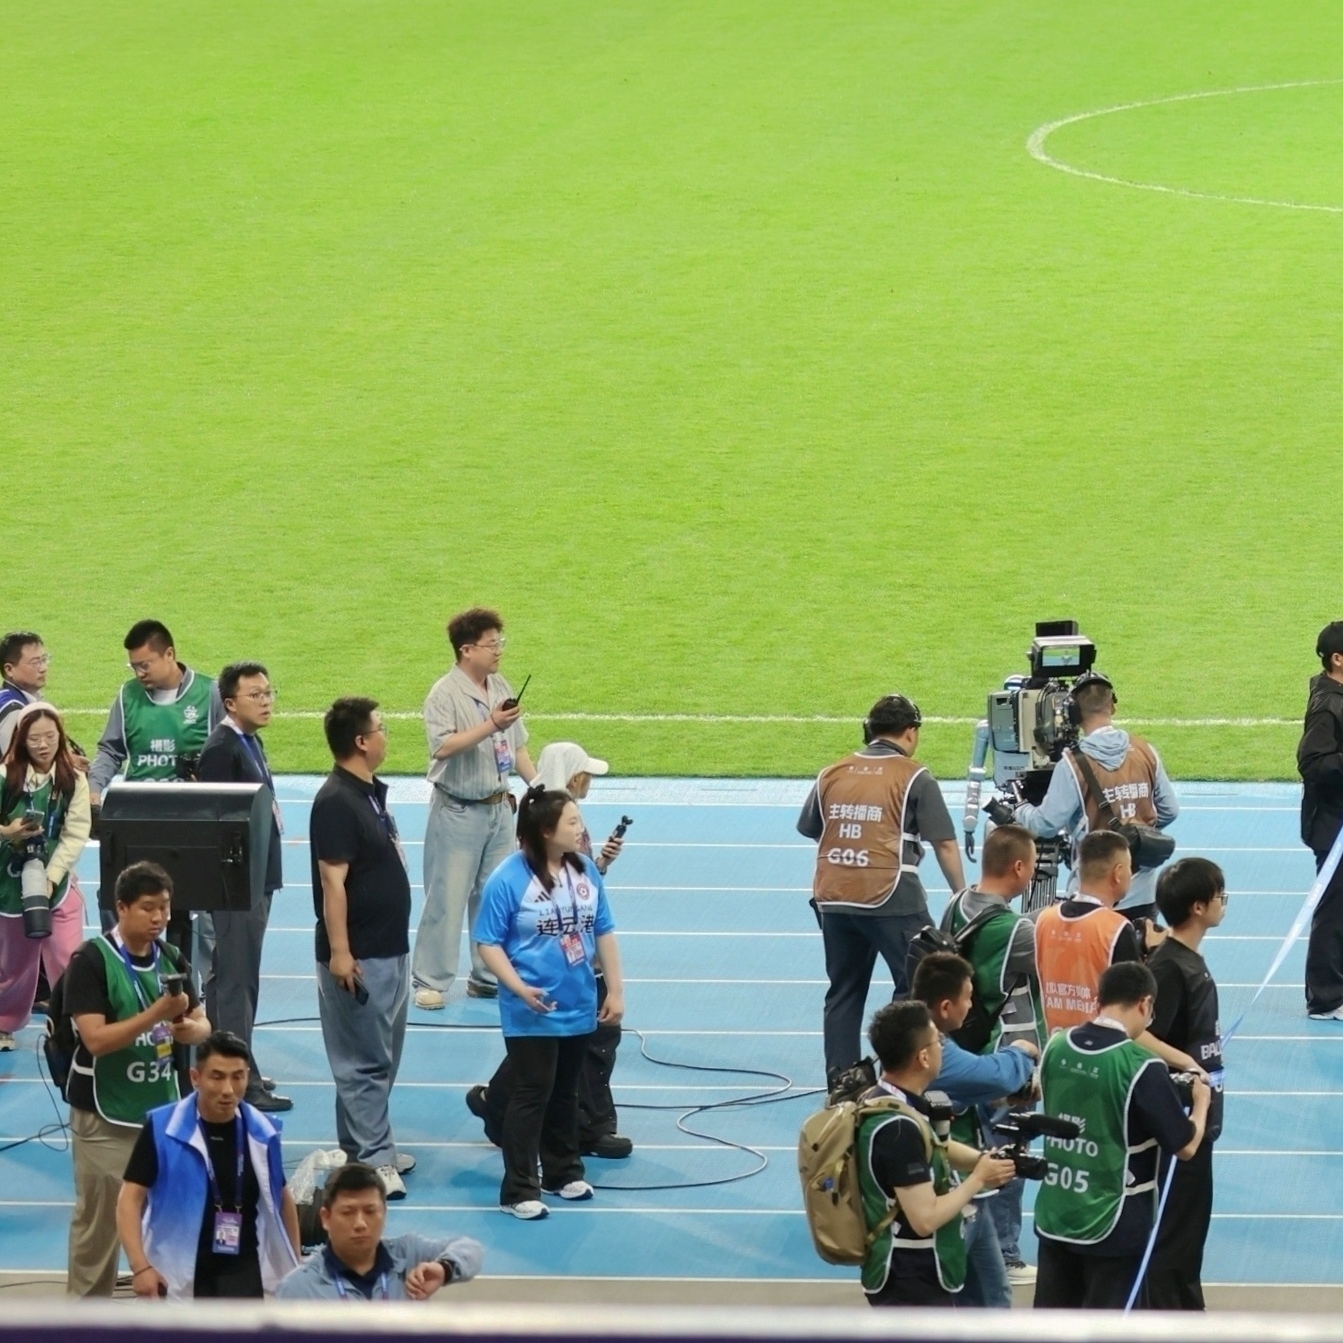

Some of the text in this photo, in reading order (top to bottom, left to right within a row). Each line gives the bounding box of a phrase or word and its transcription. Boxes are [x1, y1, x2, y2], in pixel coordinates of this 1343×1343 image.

[136, 753, 178, 767] PHOT
[828, 803, 883, 823] 主转播商
[1119, 803, 1137, 819] HB
[838, 823, 862, 839] HB
[827, 847, 870, 868] G06
[536, 914, 595, 937] 连云港
[1045, 982, 1092, 1000] 队官方媒体
[126, 1060, 173, 1083] G34
[1046, 1135, 1099, 1158] HOTO
[1044, 1161, 1091, 1194] G05
